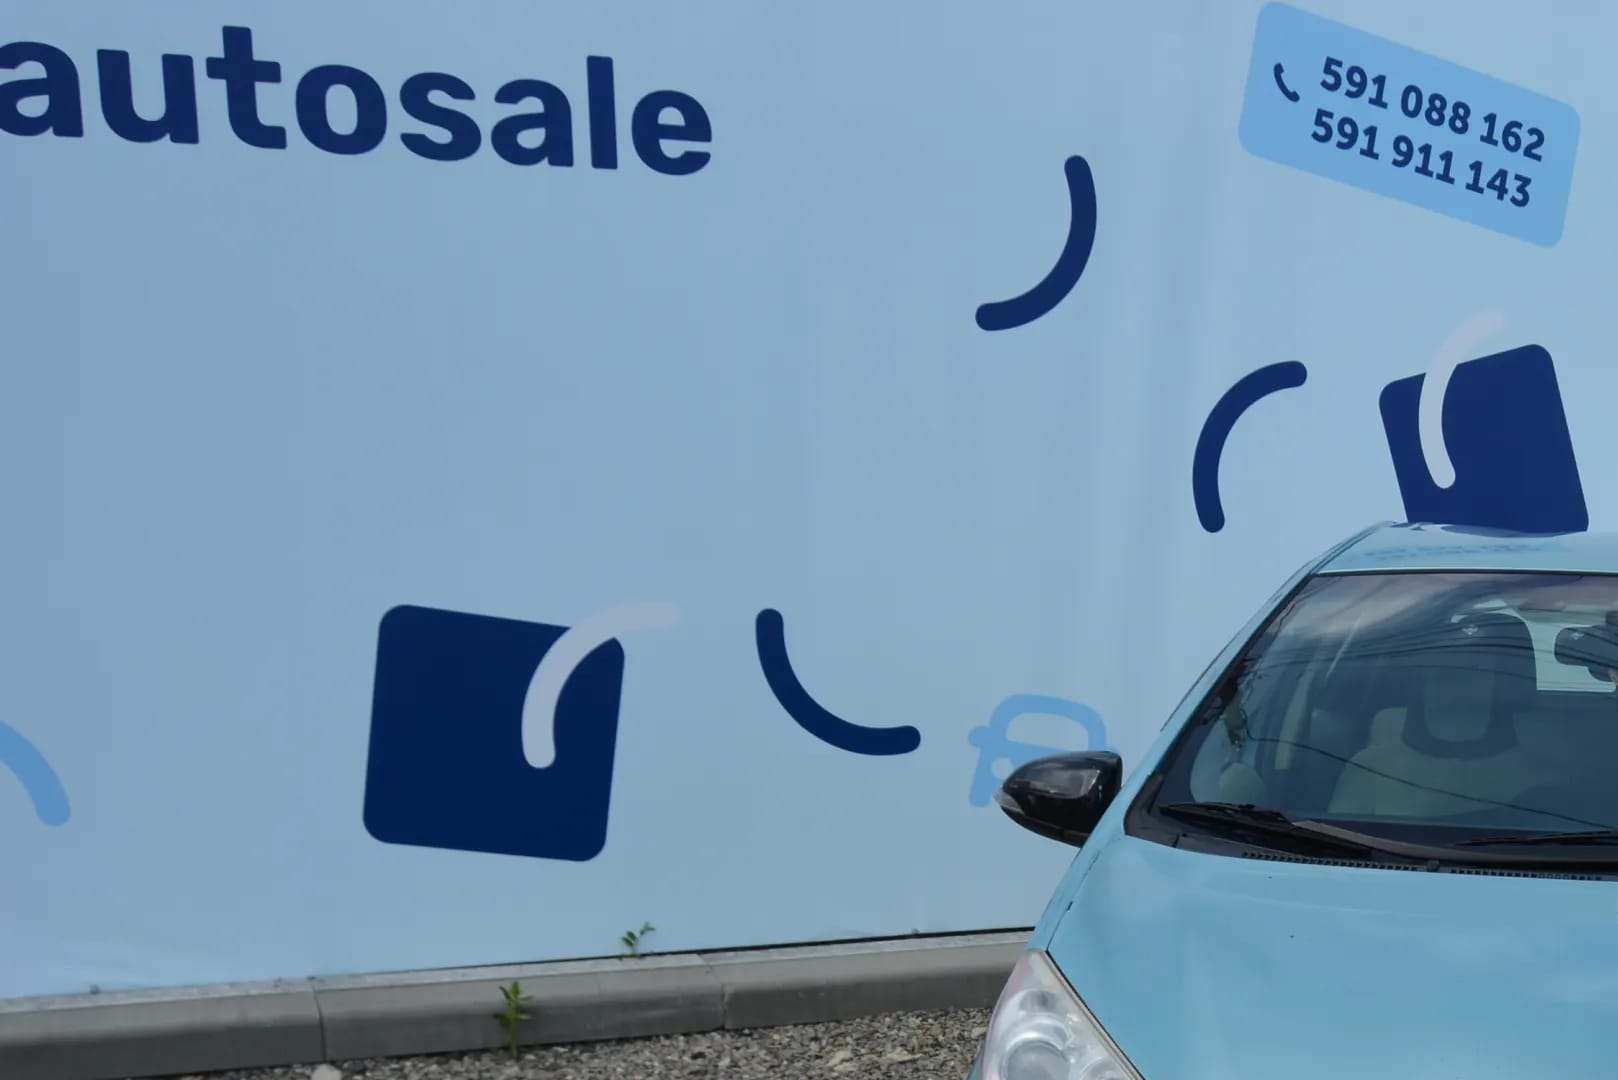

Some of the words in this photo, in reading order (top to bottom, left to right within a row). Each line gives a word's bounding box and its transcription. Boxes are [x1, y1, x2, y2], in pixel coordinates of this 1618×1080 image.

[0, 25, 713, 176] autosale
[1319, 55, 1388, 109] 591
[1401, 84, 1471, 135] 088
[1479, 112, 1545, 162] 162
[1311, 107, 1380, 160] 591
[1391, 134, 1456, 185] 911
[1465, 159, 1532, 208] 143
